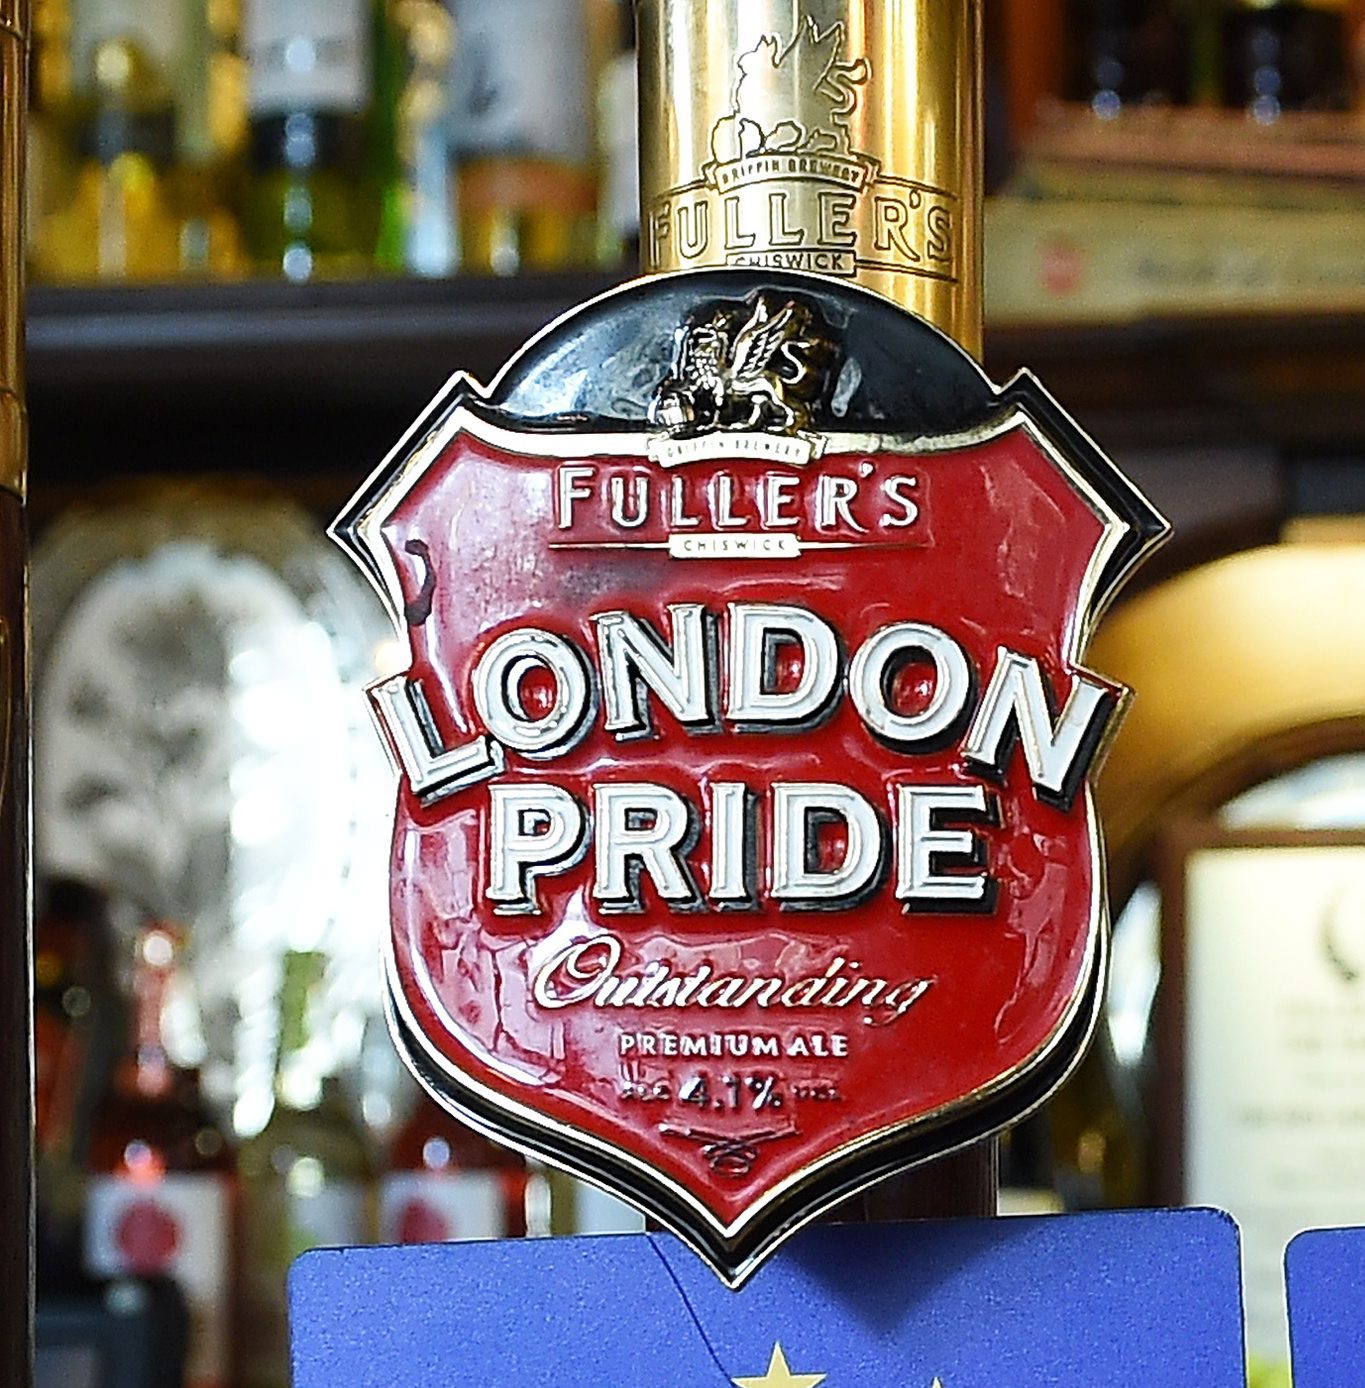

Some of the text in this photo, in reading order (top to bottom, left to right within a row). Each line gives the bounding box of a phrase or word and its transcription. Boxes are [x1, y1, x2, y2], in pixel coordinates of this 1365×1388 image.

[650, 189, 953, 268] FULLER'S
[556, 461, 920, 534] FULLER'S
[683, 539, 786, 551] CHISWICK
[368, 601, 1116, 804] LONDON
[485, 780, 998, 914] PRIDE
[534, 934, 938, 1027] Outstanding
[619, 1032, 849, 1057] PREMIUM ALE
[678, 1073, 783, 1110] 4.1%
